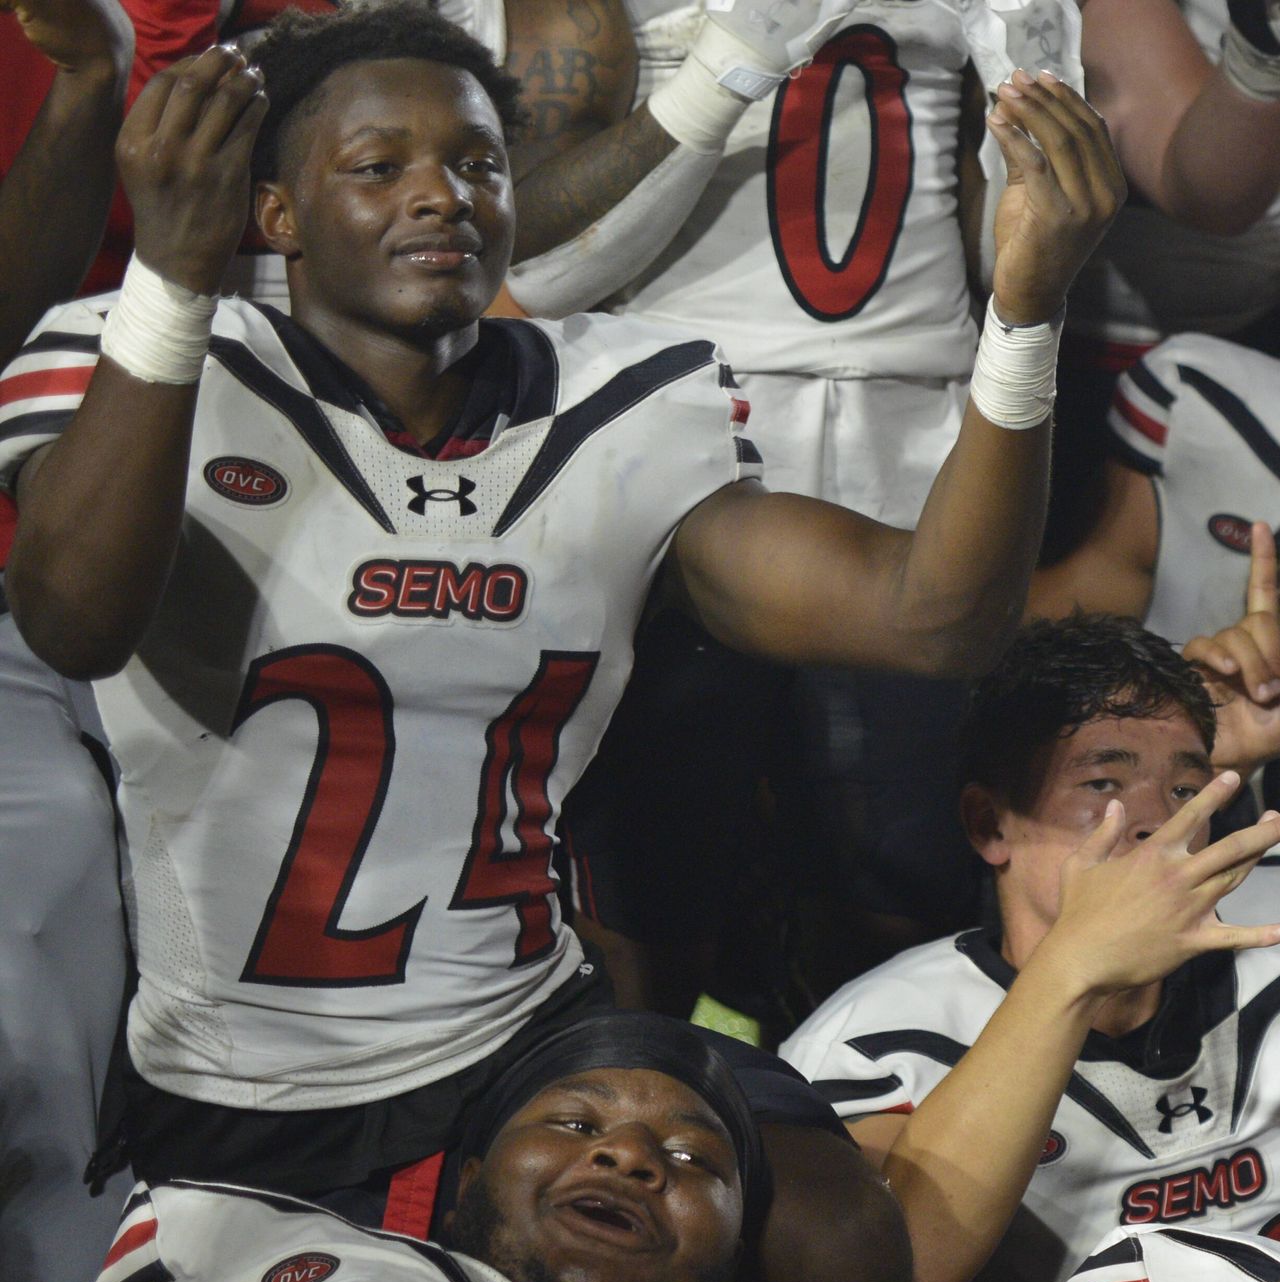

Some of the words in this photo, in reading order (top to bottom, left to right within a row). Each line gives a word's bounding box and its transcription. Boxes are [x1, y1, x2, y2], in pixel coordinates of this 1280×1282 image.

[765, 24, 913, 322] 0
[223, 469, 265, 491] OVC
[348, 559, 528, 621] SEMO
[231, 643, 601, 986] 24
[1120, 1147, 1267, 1225] SEMO
